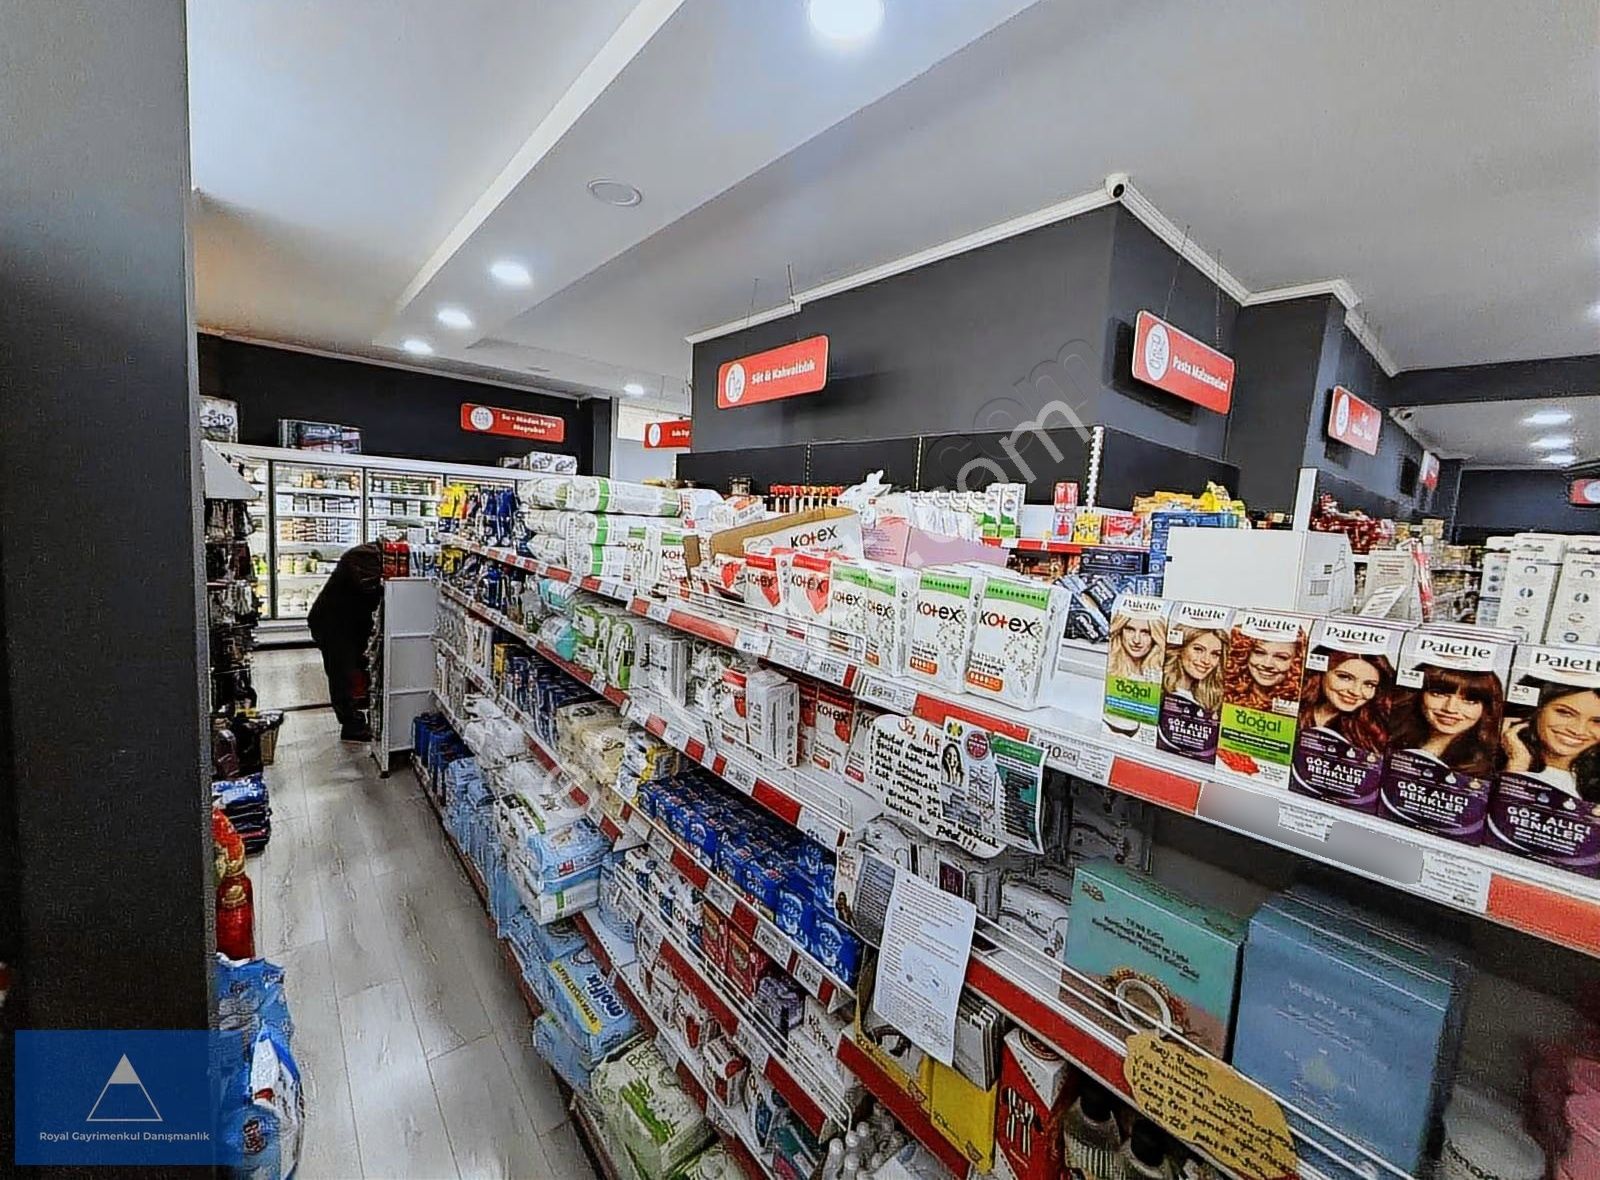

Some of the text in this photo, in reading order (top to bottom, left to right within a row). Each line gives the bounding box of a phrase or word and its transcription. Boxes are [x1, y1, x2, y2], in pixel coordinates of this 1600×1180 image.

[790, 524, 838, 548] kotex
[747, 573, 775, 588] kotex
[791, 574, 824, 593] kotex
[917, 600, 961, 624] kotex
[1123, 598, 1162, 612] Palette
[1182, 605, 1225, 621] Palette
[979, 609, 1037, 637] kotex
[1245, 616, 1296, 633] Palette
[1326, 626, 1385, 643] Palette
[1420, 639, 1491, 659] Palette
[1116, 679, 1151, 699] doğal
[1235, 708, 1282, 733] doğal
[1306, 756, 1366, 779] GÖZ ALICI
[1307, 764, 1362, 786] RENKLER
[1397, 781, 1468, 807] GÖZ ALICI
[1399, 789, 1464, 814] RENKLER
[1507, 806, 1592, 836] GÖZ ALICI
[1509, 815, 1586, 843] RENKLER
[587, 973, 624, 1017] molfix
